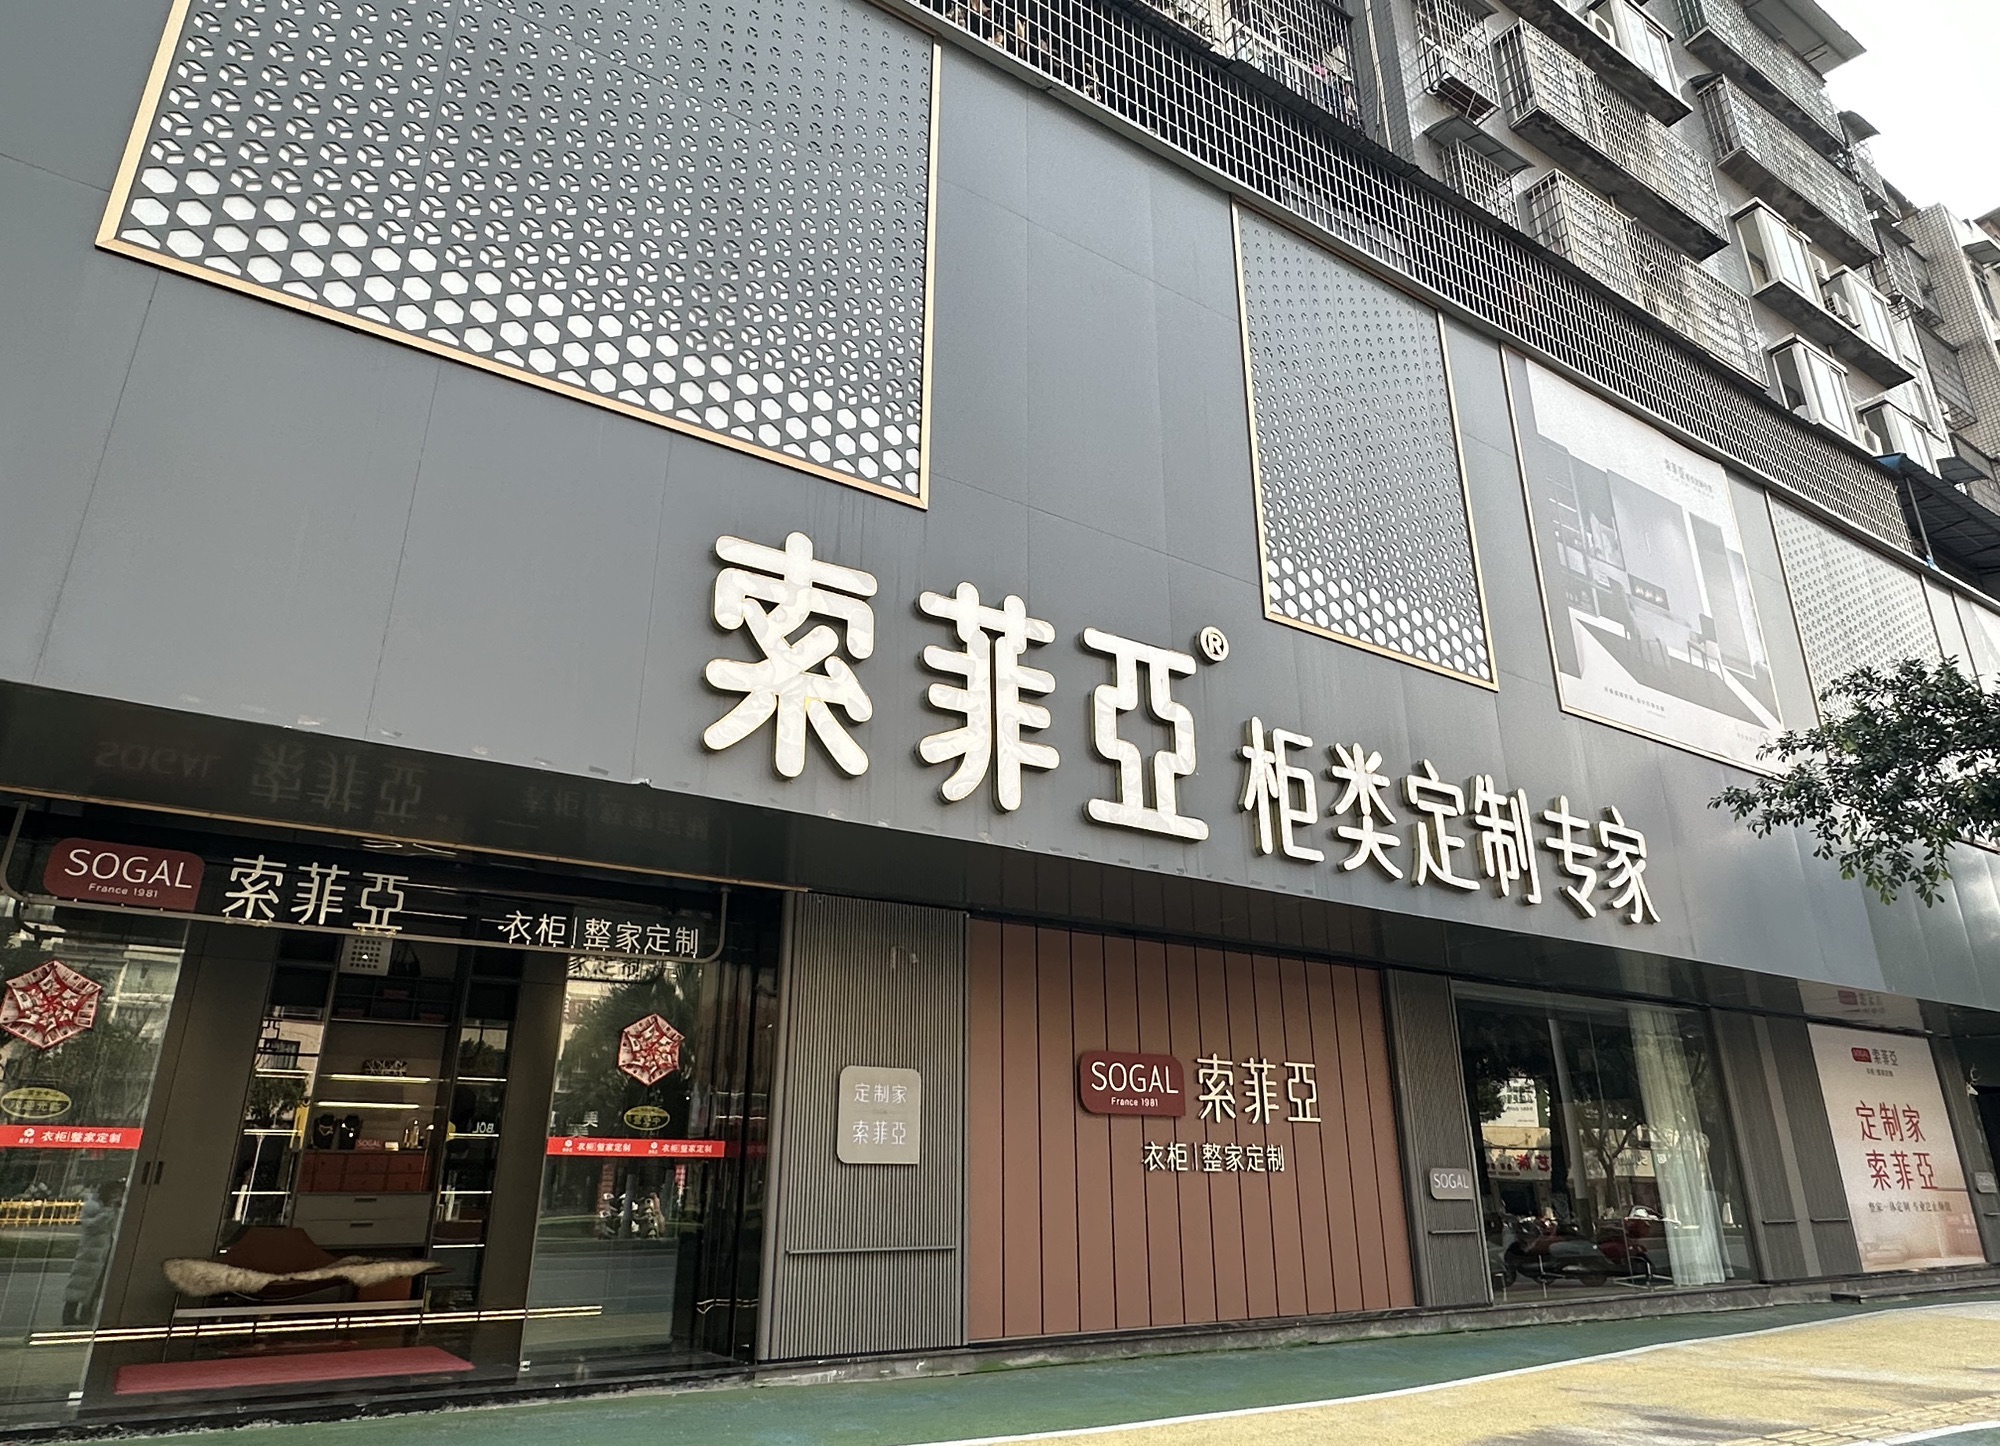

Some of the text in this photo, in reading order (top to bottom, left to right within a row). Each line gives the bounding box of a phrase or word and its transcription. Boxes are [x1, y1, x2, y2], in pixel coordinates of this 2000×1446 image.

[1238, 716, 1660, 924] 柜类定制专家
[64, 848, 193, 889] SOGAL
[88, 882, 158, 898] France 1981
[221, 854, 409, 931] 索菲亞
[853, 1082, 908, 1104] 定制家
[1091, 1062, 1179, 1094] SOGAL
[1197, 1053, 1321, 1125] 索菲亞
[1110, 1096, 1159, 1107] France 1981
[852, 1119, 907, 1146] 索菲亞
[1855, 1100, 1927, 1143] 定制家
[1433, 1173, 1469, 1189] SOGAL
[1865, 1149, 1938, 1191] 索菲亞
